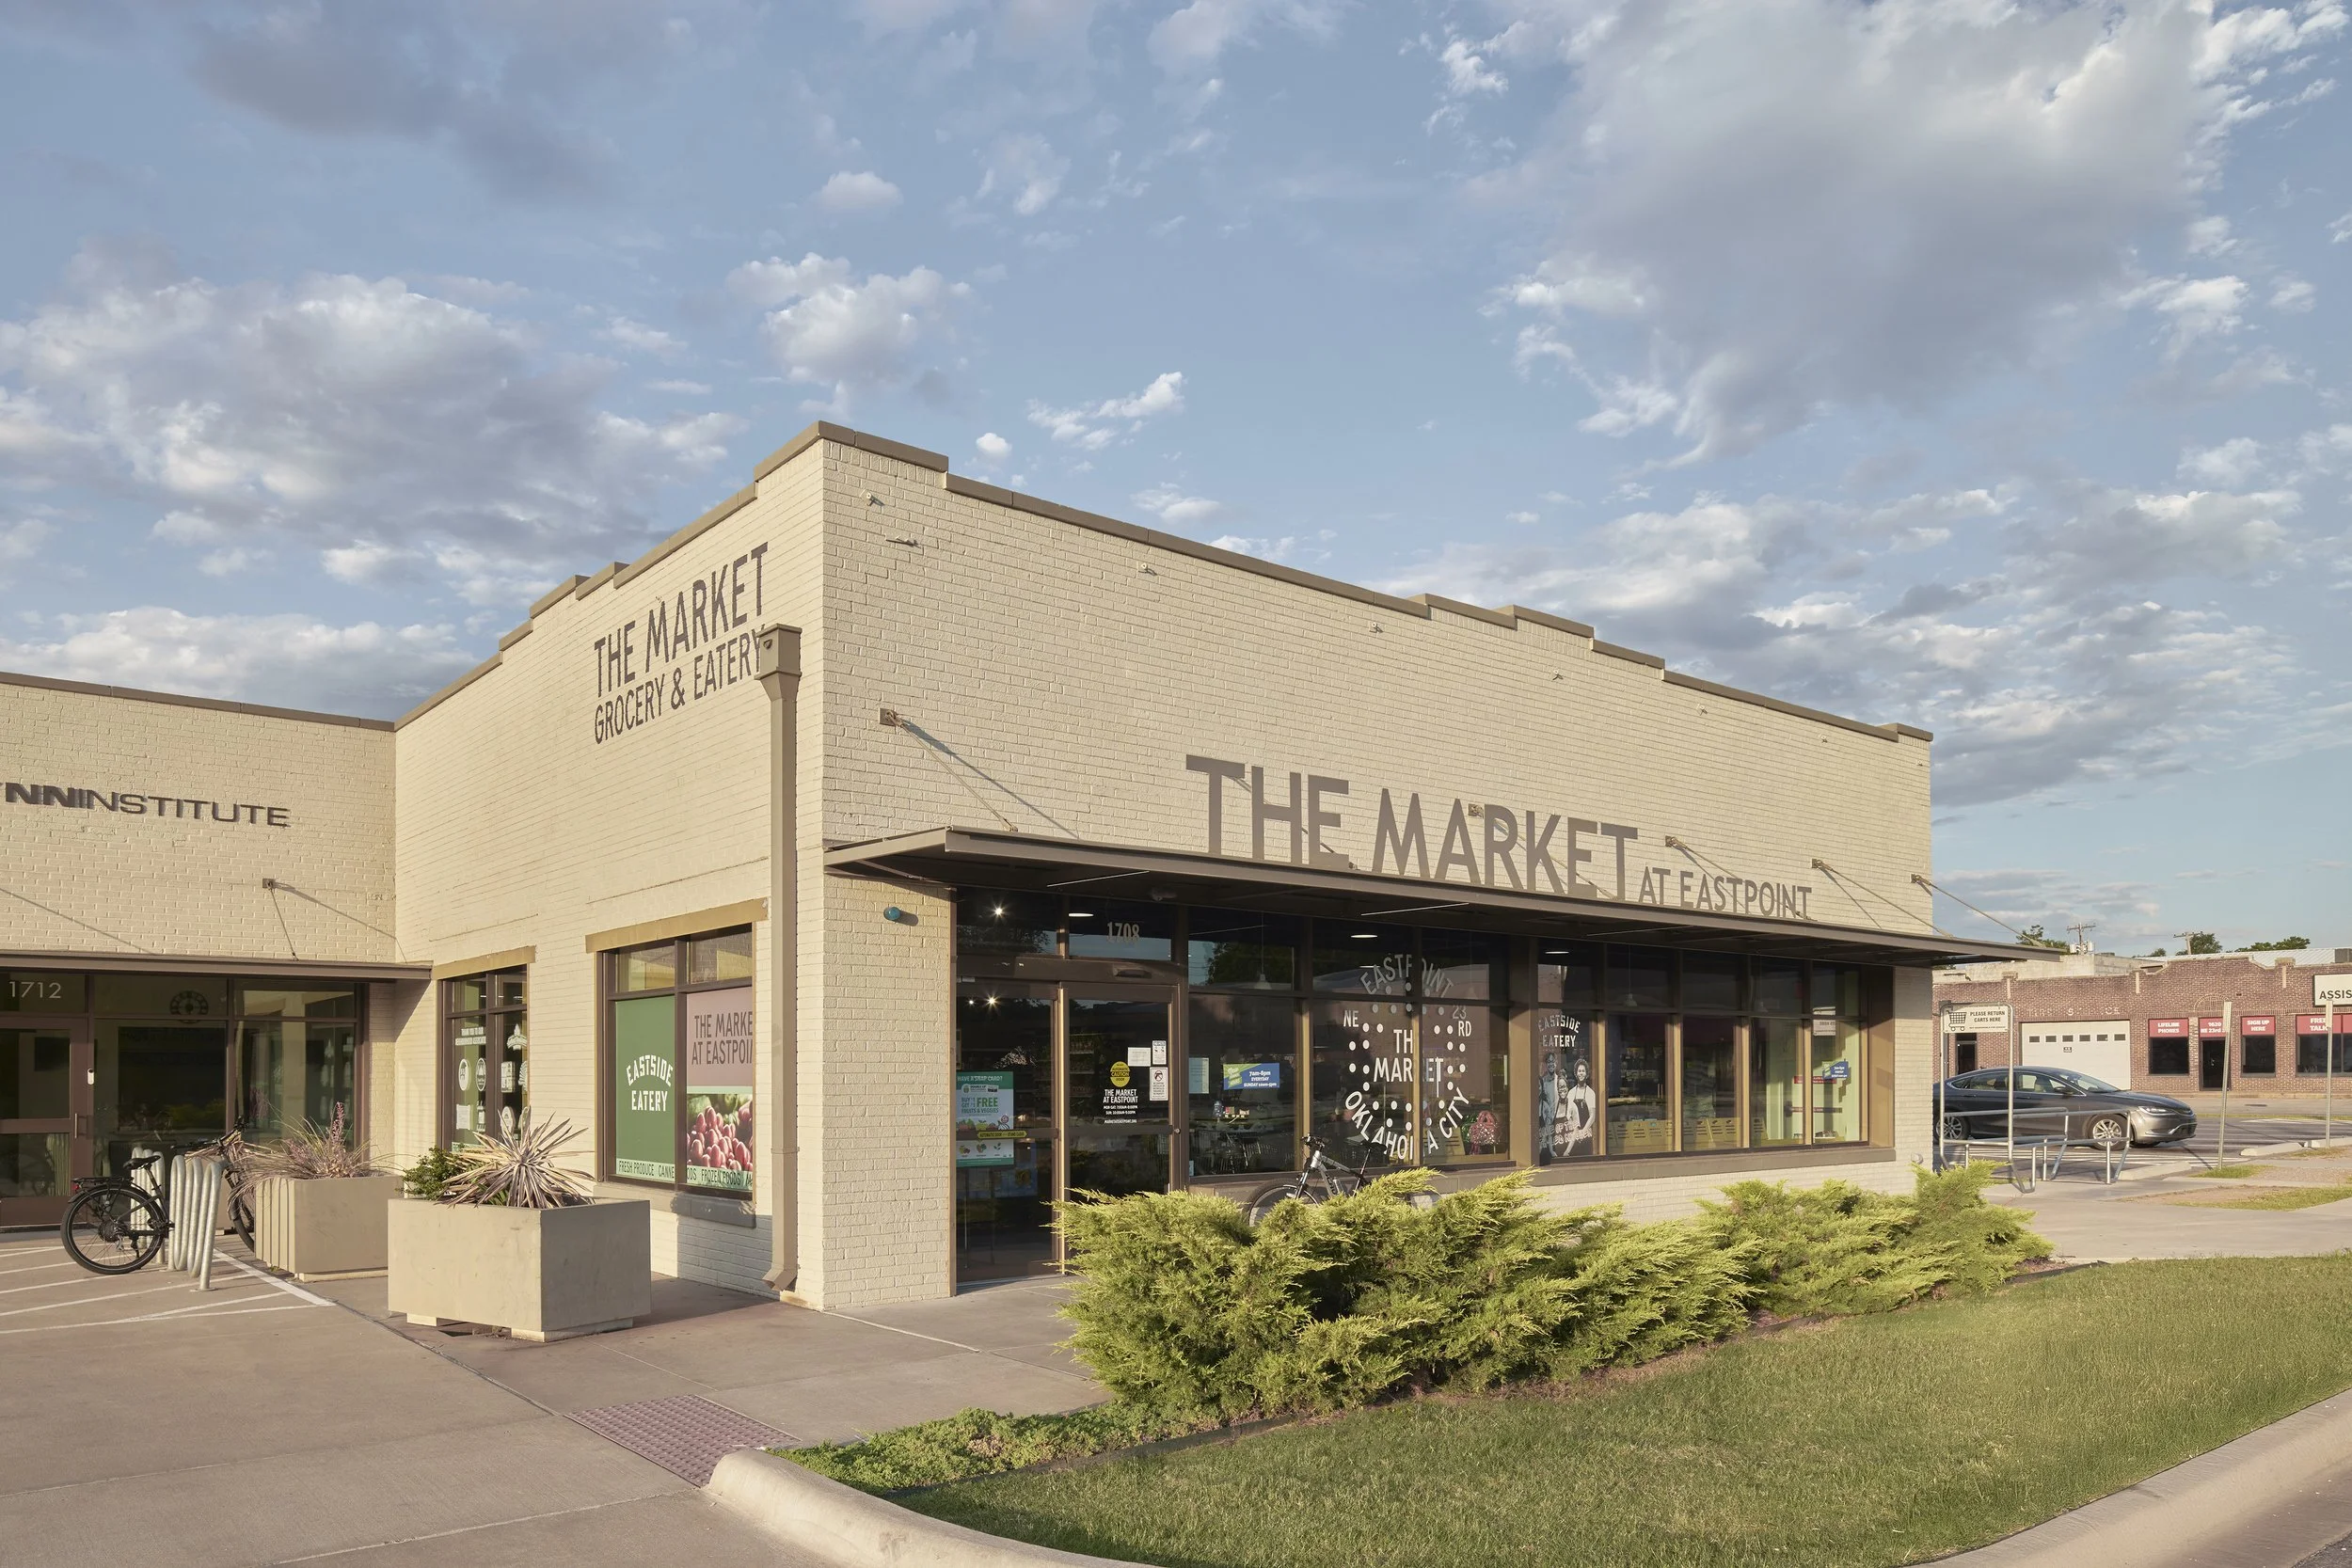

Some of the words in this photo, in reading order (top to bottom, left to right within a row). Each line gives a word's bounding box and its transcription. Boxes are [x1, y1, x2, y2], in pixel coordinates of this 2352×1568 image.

[594, 619, 636, 699] THE
[644, 541, 769, 673] MARKET
[594, 673, 665, 745] GROCERY
[670, 667, 686, 710] &
[693, 624, 766, 701] EATERY
[1185, 754, 1350, 870] THE
[1372, 787, 1638, 903] MARKET
[1638, 865, 1671, 906] AT
[1679, 870, 1812, 920] EASTPOINT
[1107, 921, 1141, 942] 1708
[8, 980, 62, 999] 1712
[1343, 1010, 1359, 1028] NE
[1452, 1005, 1467, 1021] 23
[1538, 1015, 1581, 1033] EASTSIDE
[694, 1014, 712, 1039] THE
[715, 1011, 753, 1037] MARKE
[1457, 1021, 1471, 1037] RD
[691, 1041, 703, 1066] AT
[706, 1038, 753, 1065] EASTPOI
[1393, 1029, 1413, 1053] TH
[1542, 1035, 1577, 1048] EATERY
[626, 1054, 674, 1087] EASTSIDE
[1374, 1057, 1444, 1083] MARET
[631, 1090, 669, 1113] EATERY
[977, 1097, 998, 1107] FREE
[1115, 1088, 1137, 1097] MARKET
[1438, 1086, 1470, 1139] CITY
[618, 1160, 633, 1174] FRESH
[633, 1161, 655, 1177] PRODUCE
[658, 1164, 675, 1180] CANNE
[687, 1167, 697, 1181] ODS
[701, 1168, 723, 1184] FROZEN
[723, 1169, 741, 1186] FOODS
